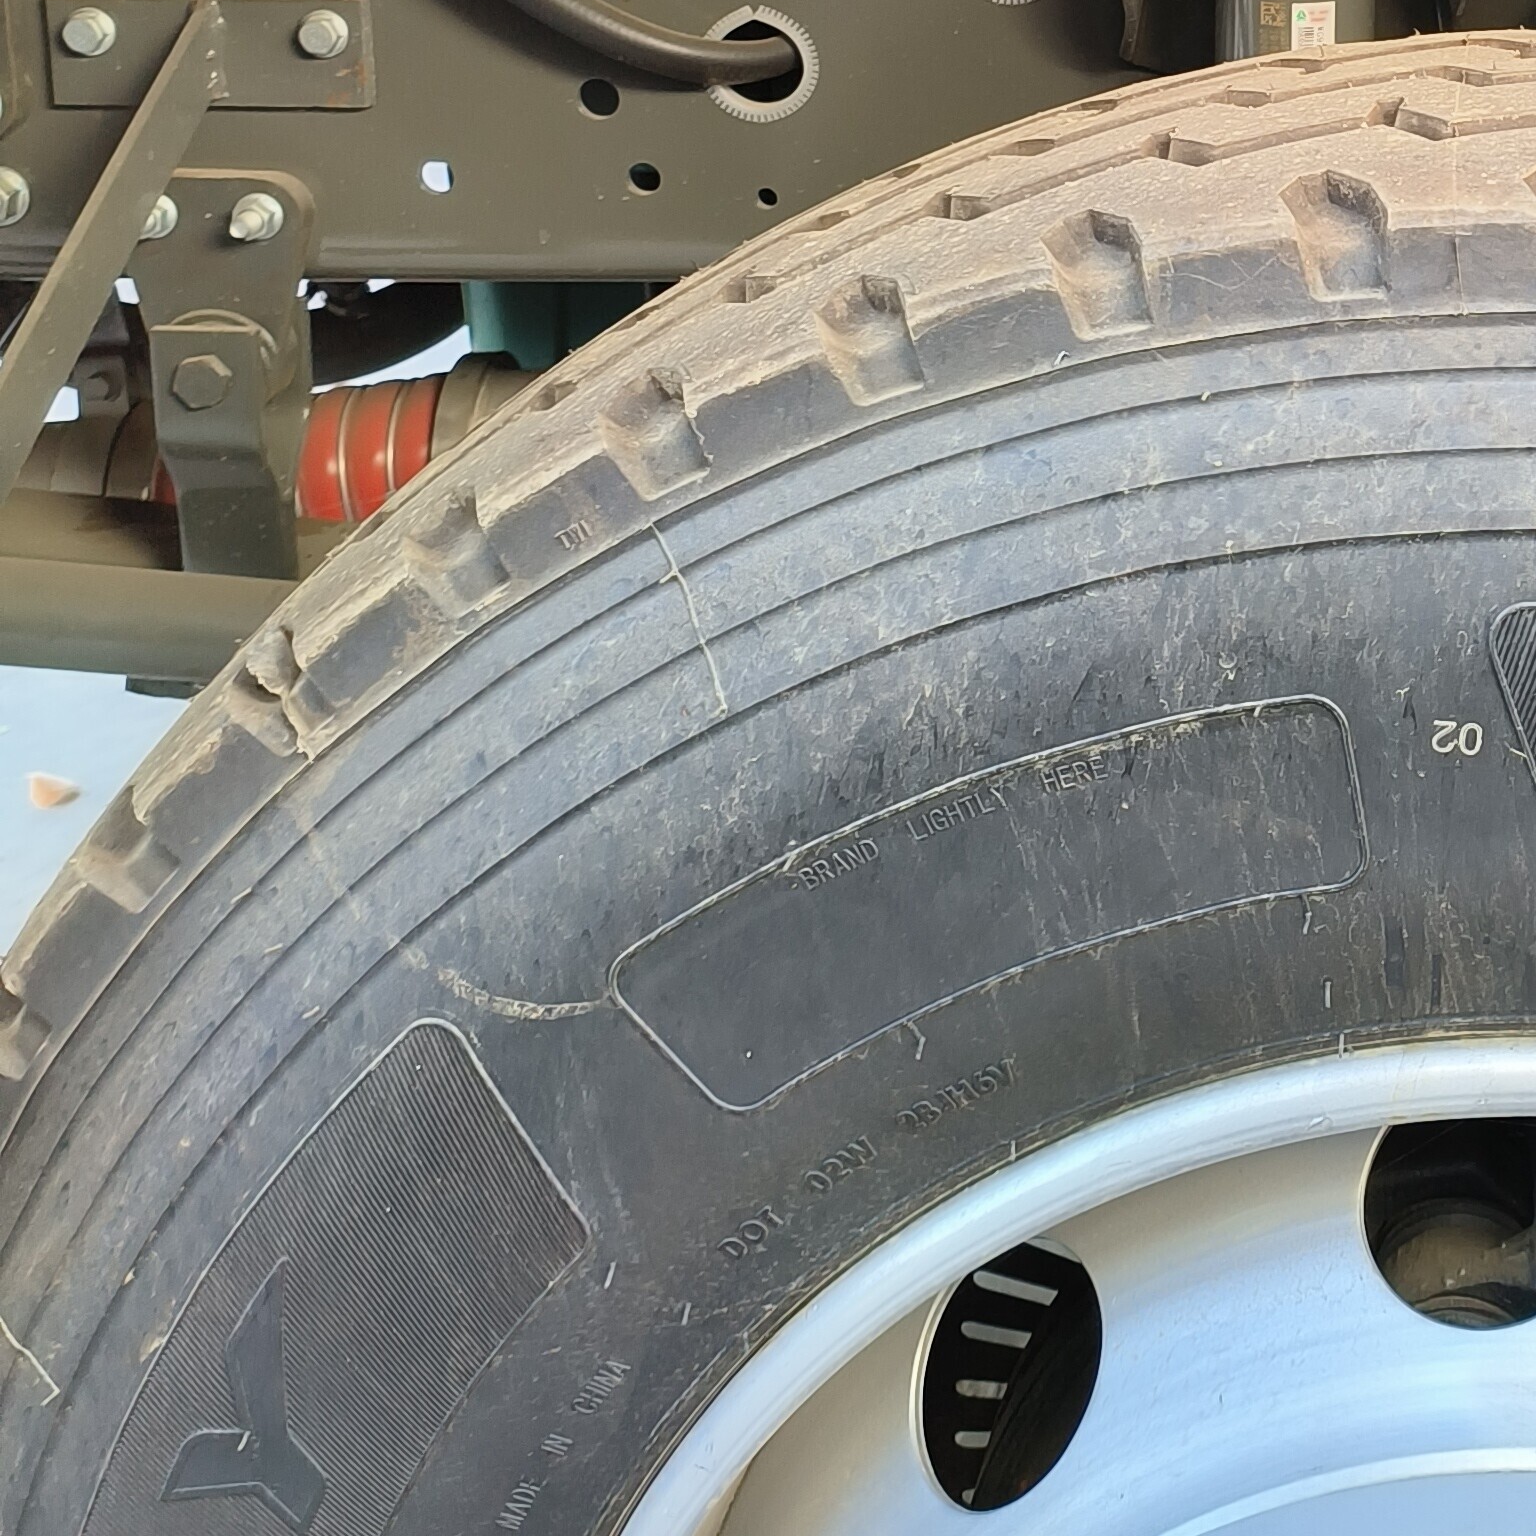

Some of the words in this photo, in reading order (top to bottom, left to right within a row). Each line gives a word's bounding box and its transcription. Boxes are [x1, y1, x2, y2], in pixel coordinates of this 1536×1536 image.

[797, 837, 881, 891] BRAND
[905, 783, 1012, 842] LIGHTLY
[1040, 755, 1110, 794] HERE
[716, 1204, 786, 1260] DOT
[494, 1476, 546, 1531] MADE
[540, 1432, 574, 1457] IN
[571, 1359, 632, 1415] CHINA
